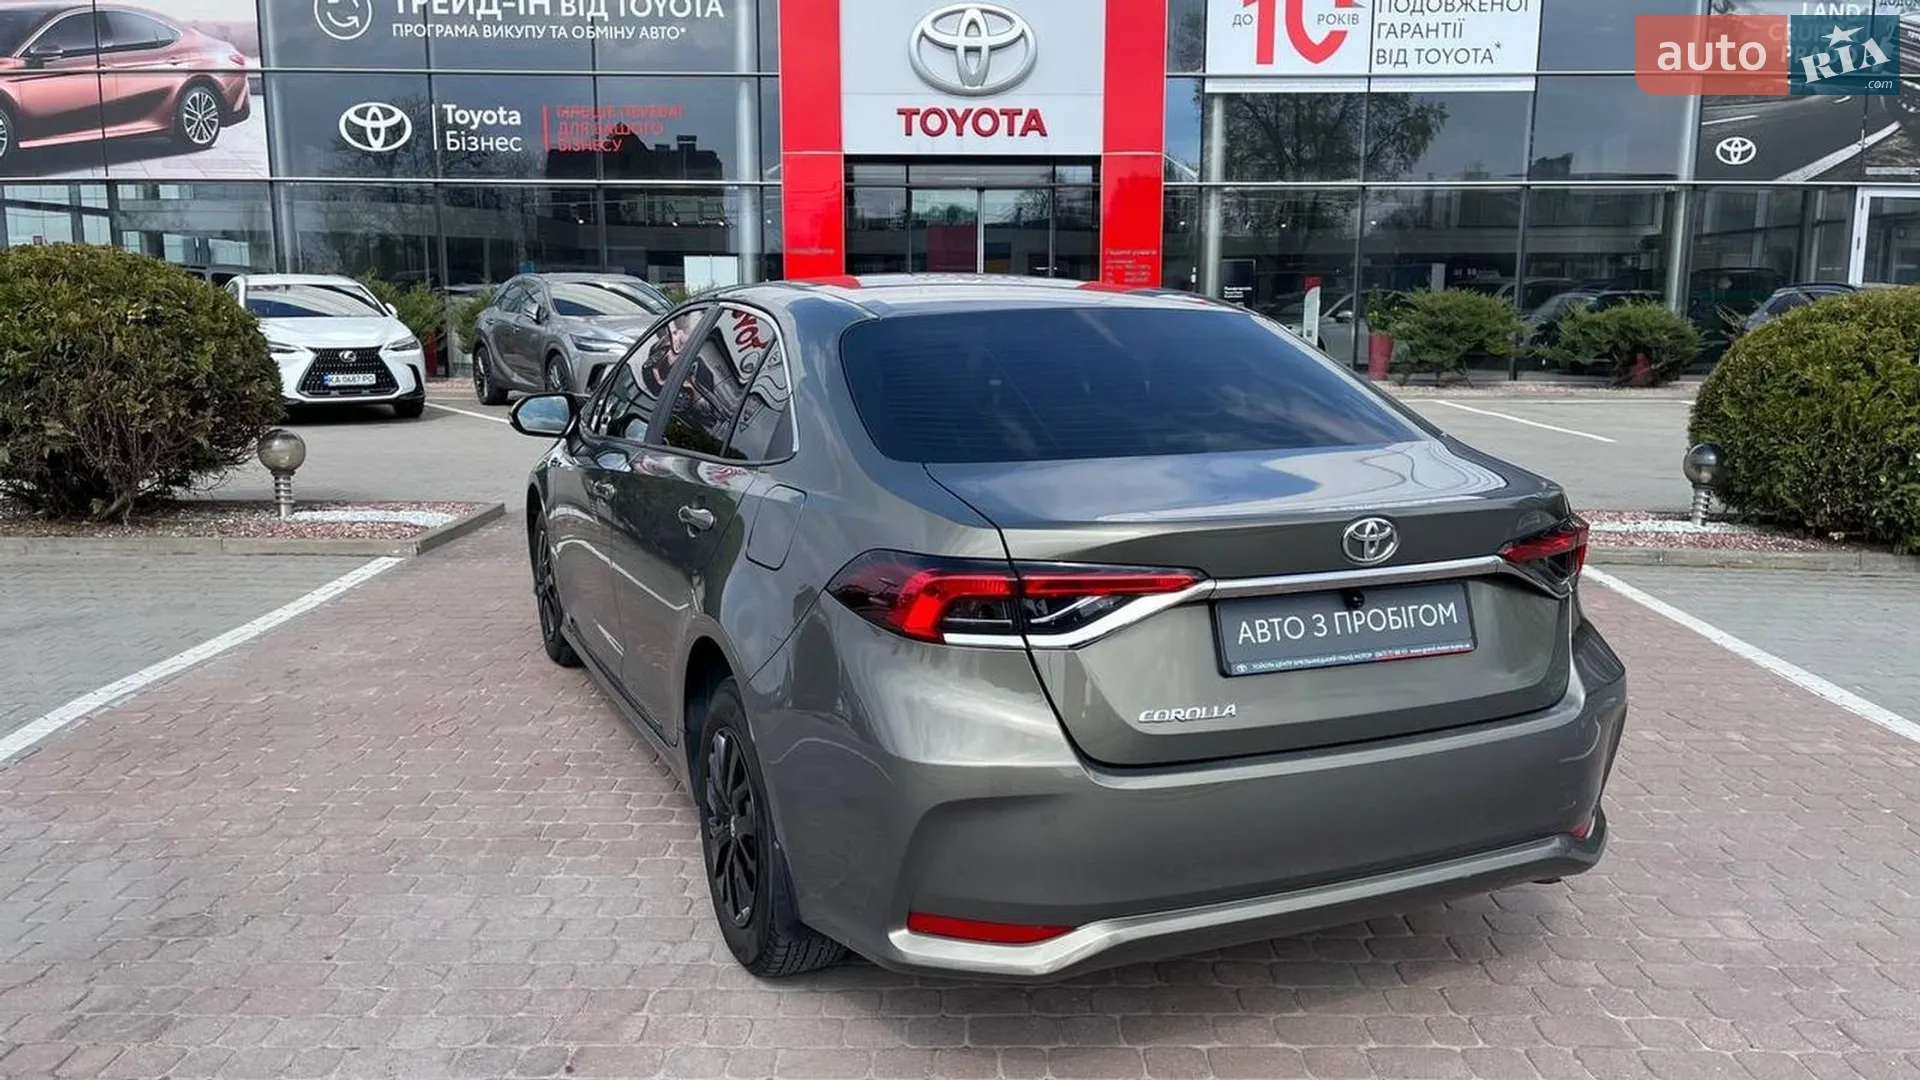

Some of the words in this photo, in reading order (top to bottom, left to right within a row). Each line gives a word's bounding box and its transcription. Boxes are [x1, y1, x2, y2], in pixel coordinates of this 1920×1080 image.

[561, 0, 609, 22] ВІД
[617, 0, 725, 18] TOYOTA
[1232, 14, 1253, 28] ДО
[1317, 13, 1360, 26] РОКІВ
[392, 23, 479, 38] ПРОГРАМА
[483, 24, 546, 39] ВИКУПУ
[549, 25, 568, 39] ТА
[571, 25, 635, 40] ОБМІНУ
[1377, 18, 1465, 39] ГАРАНТІЇ
[1376, 48, 1408, 68] ВІД
[442, 103, 522, 129] Toyota
[896, 107, 1048, 137] TOYOTA
[446, 131, 522, 151] Бізнес
[1238, 615, 1305, 645] АВТО
[1312, 613, 1328, 637] З
[1334, 602, 1458, 635] ПРОБІГОМ
[1138, 703, 1236, 723] COROLLA
